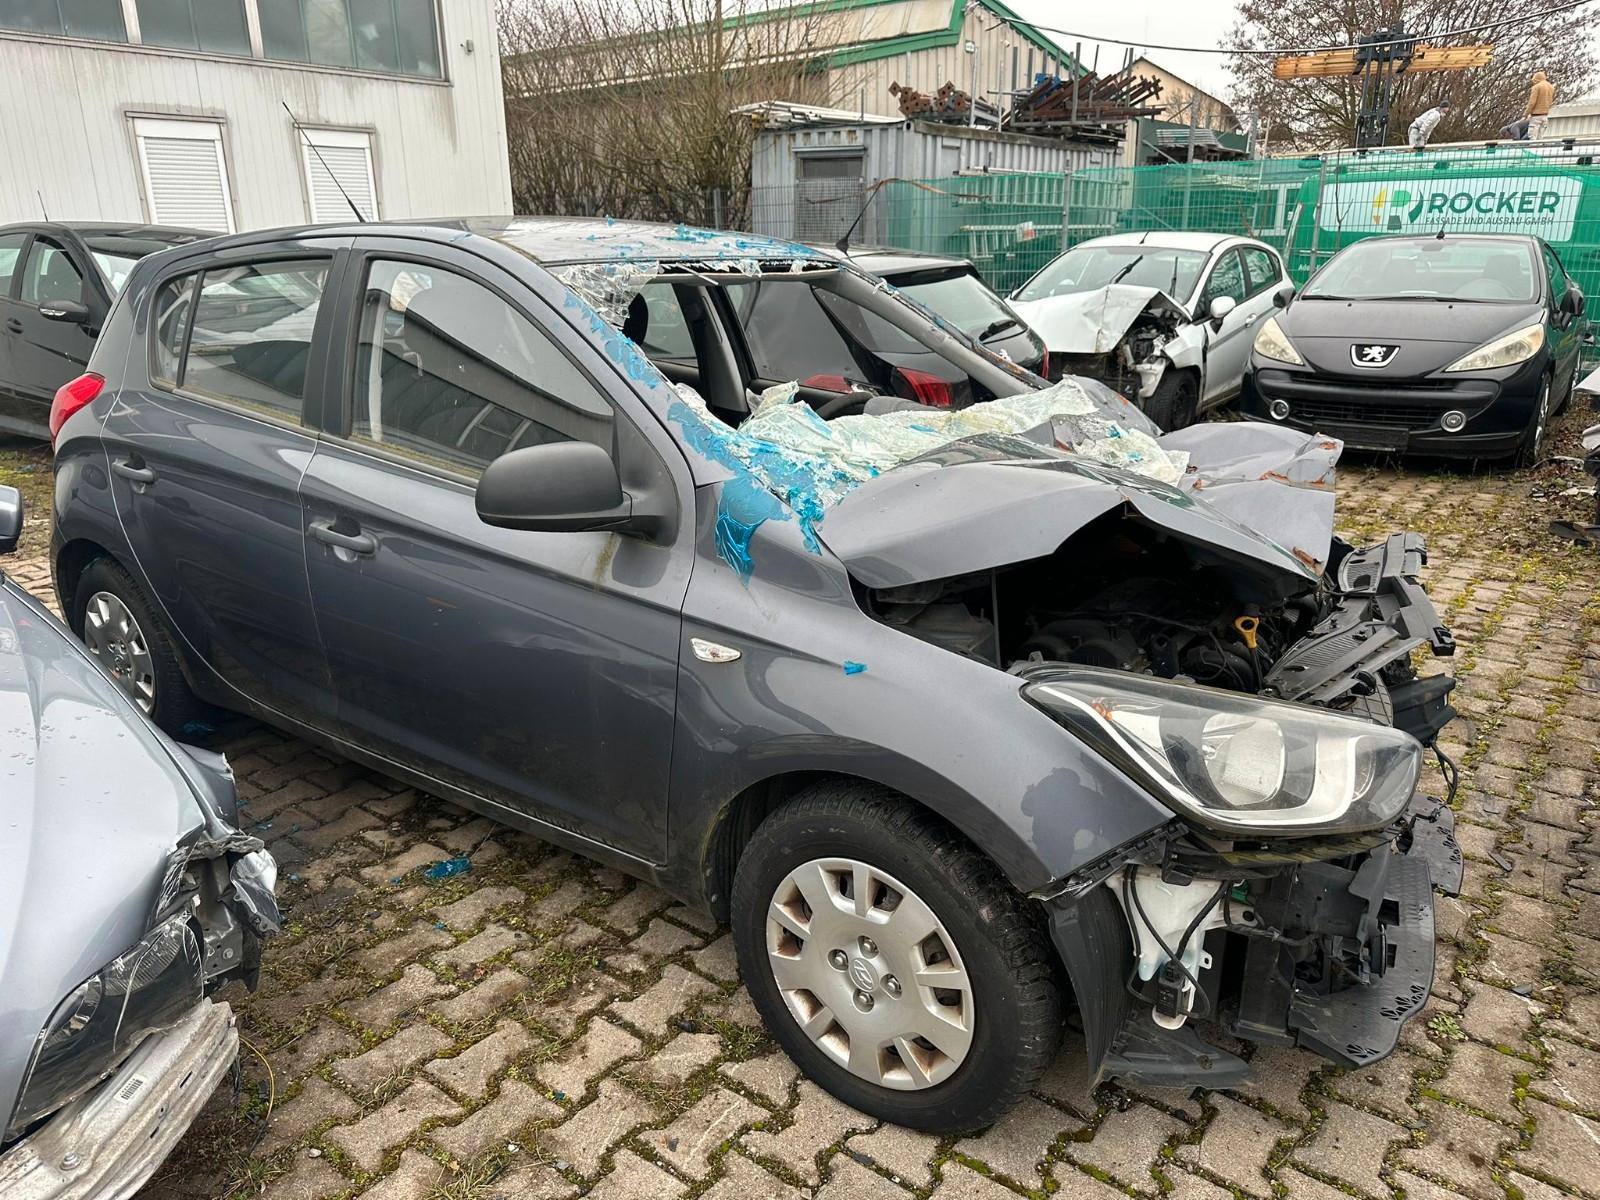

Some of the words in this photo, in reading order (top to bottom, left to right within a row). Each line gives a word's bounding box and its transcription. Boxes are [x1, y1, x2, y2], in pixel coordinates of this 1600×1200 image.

[1428, 191, 1560, 214] ROCKER
[1425, 216, 1462, 225] FASSADE
[1464, 216, 1484, 225] UND
[1485, 216, 1522, 225] AUSBAU
[1524, 216, 1554, 226] GMBH
